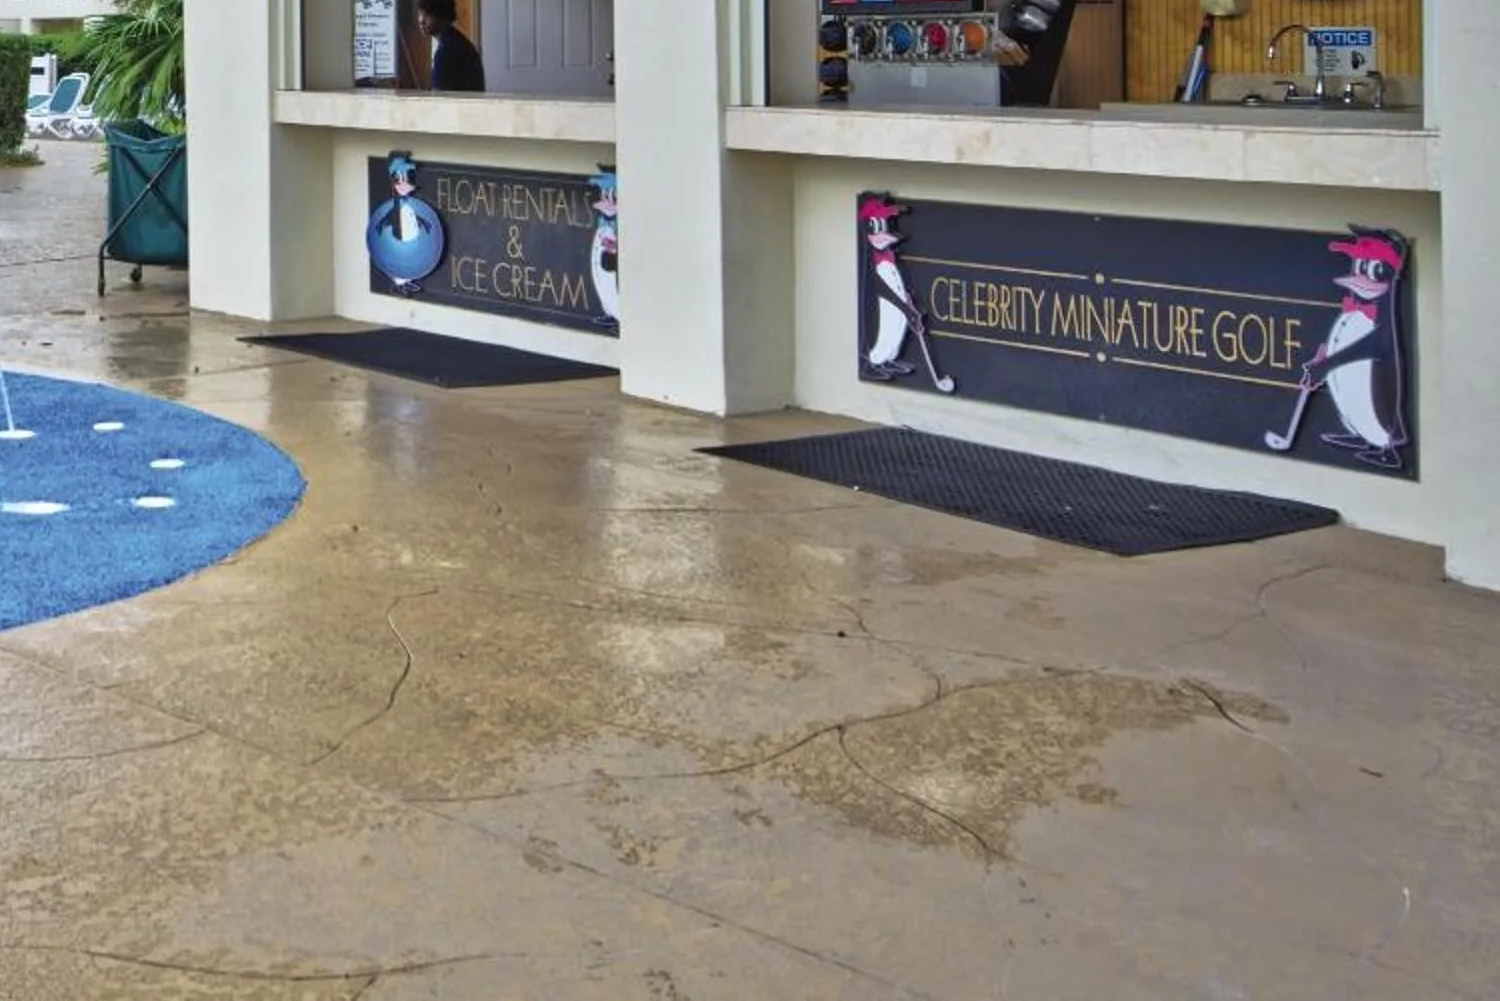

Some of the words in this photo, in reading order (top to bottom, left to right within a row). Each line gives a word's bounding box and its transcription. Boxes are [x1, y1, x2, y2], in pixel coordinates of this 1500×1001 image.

[437, 178, 496, 216] FLOAT
[502, 183, 594, 228] RENTALS
[506, 225, 526, 261] &
[451, 256, 489, 294] ICE
[493, 261, 590, 312] CREAM
[930, 276, 1046, 335] CELEBRITY
[1050, 290, 1208, 359] MINIATURE
[1211, 309, 1302, 370] GOLF
